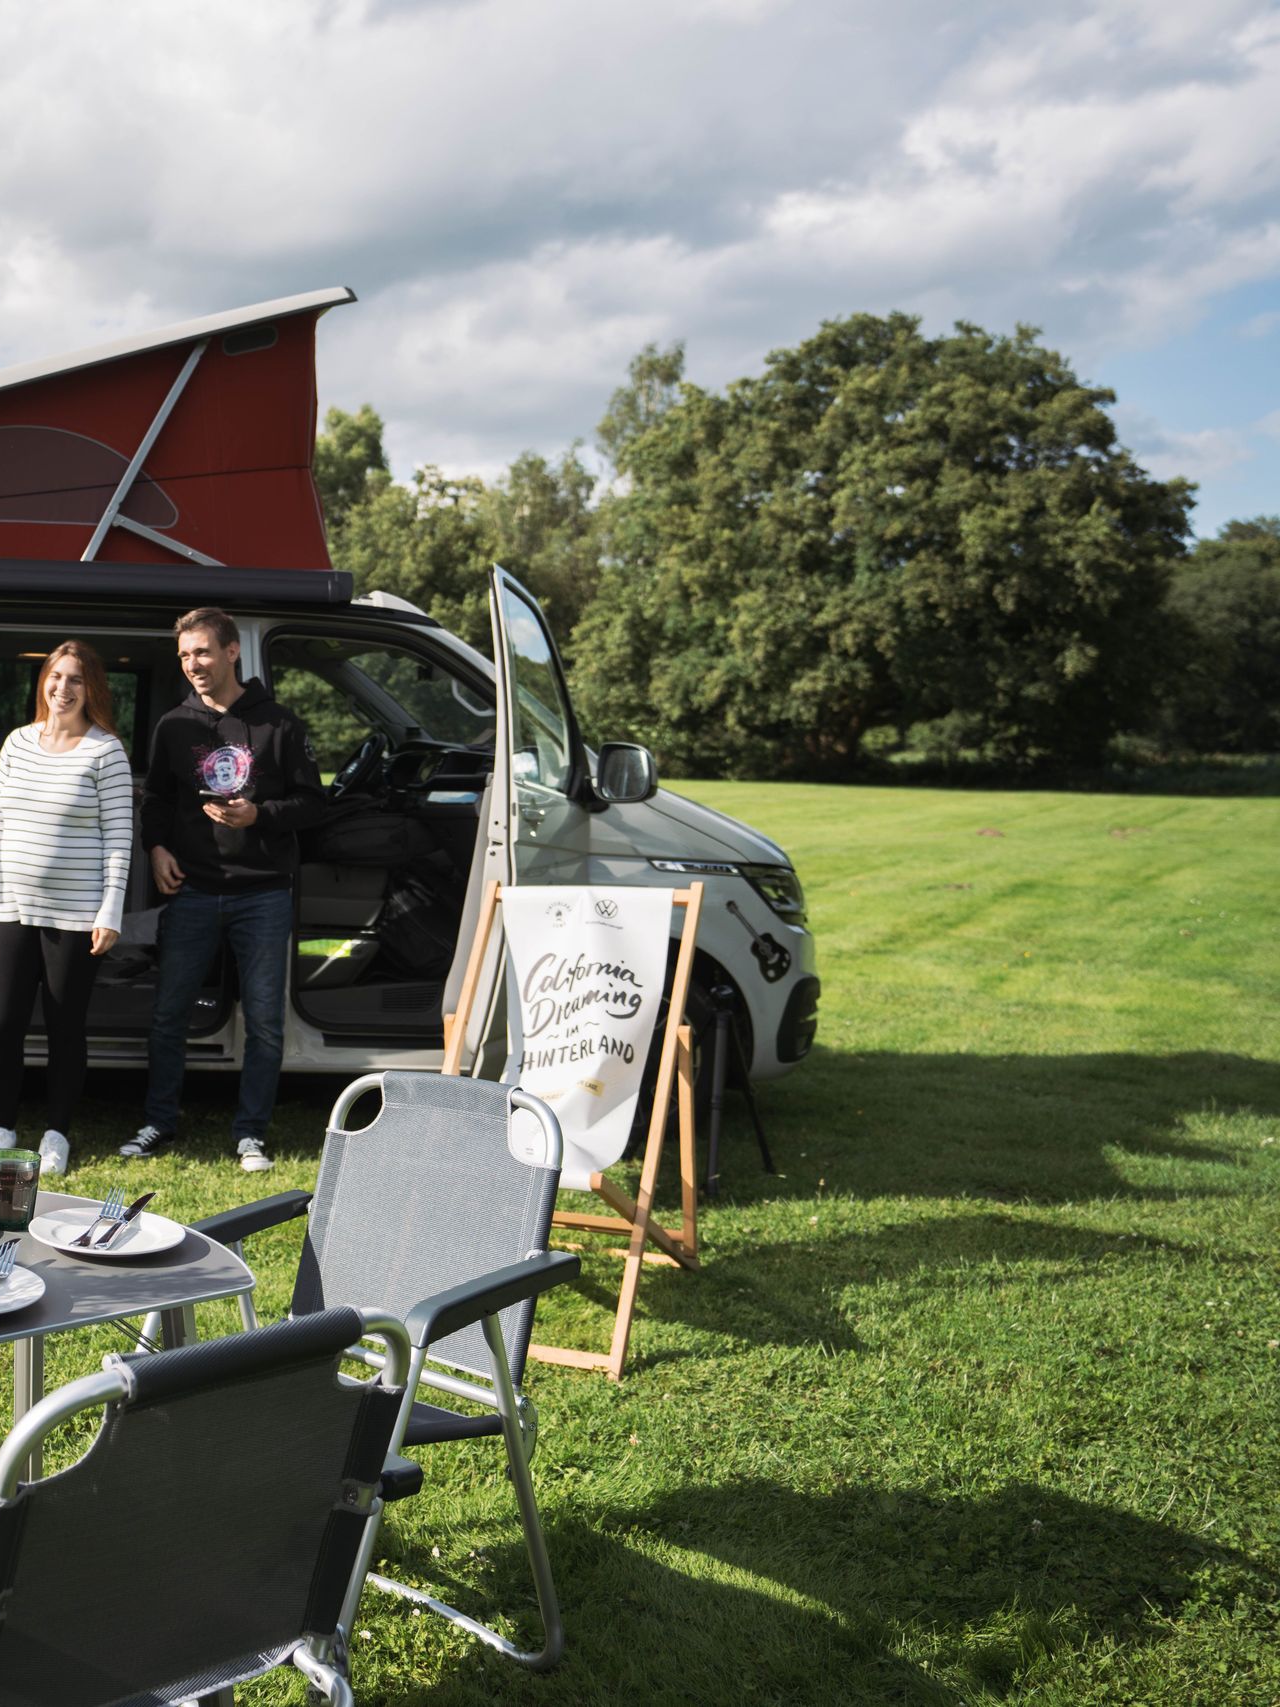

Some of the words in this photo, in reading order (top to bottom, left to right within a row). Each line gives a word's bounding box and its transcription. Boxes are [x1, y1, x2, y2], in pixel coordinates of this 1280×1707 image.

[523, 953, 644, 1004] California
[522, 983, 643, 1039] Dreaming
[566, 1026, 579, 1039] IM
[518, 1034, 634, 1074] HINTERLAND
